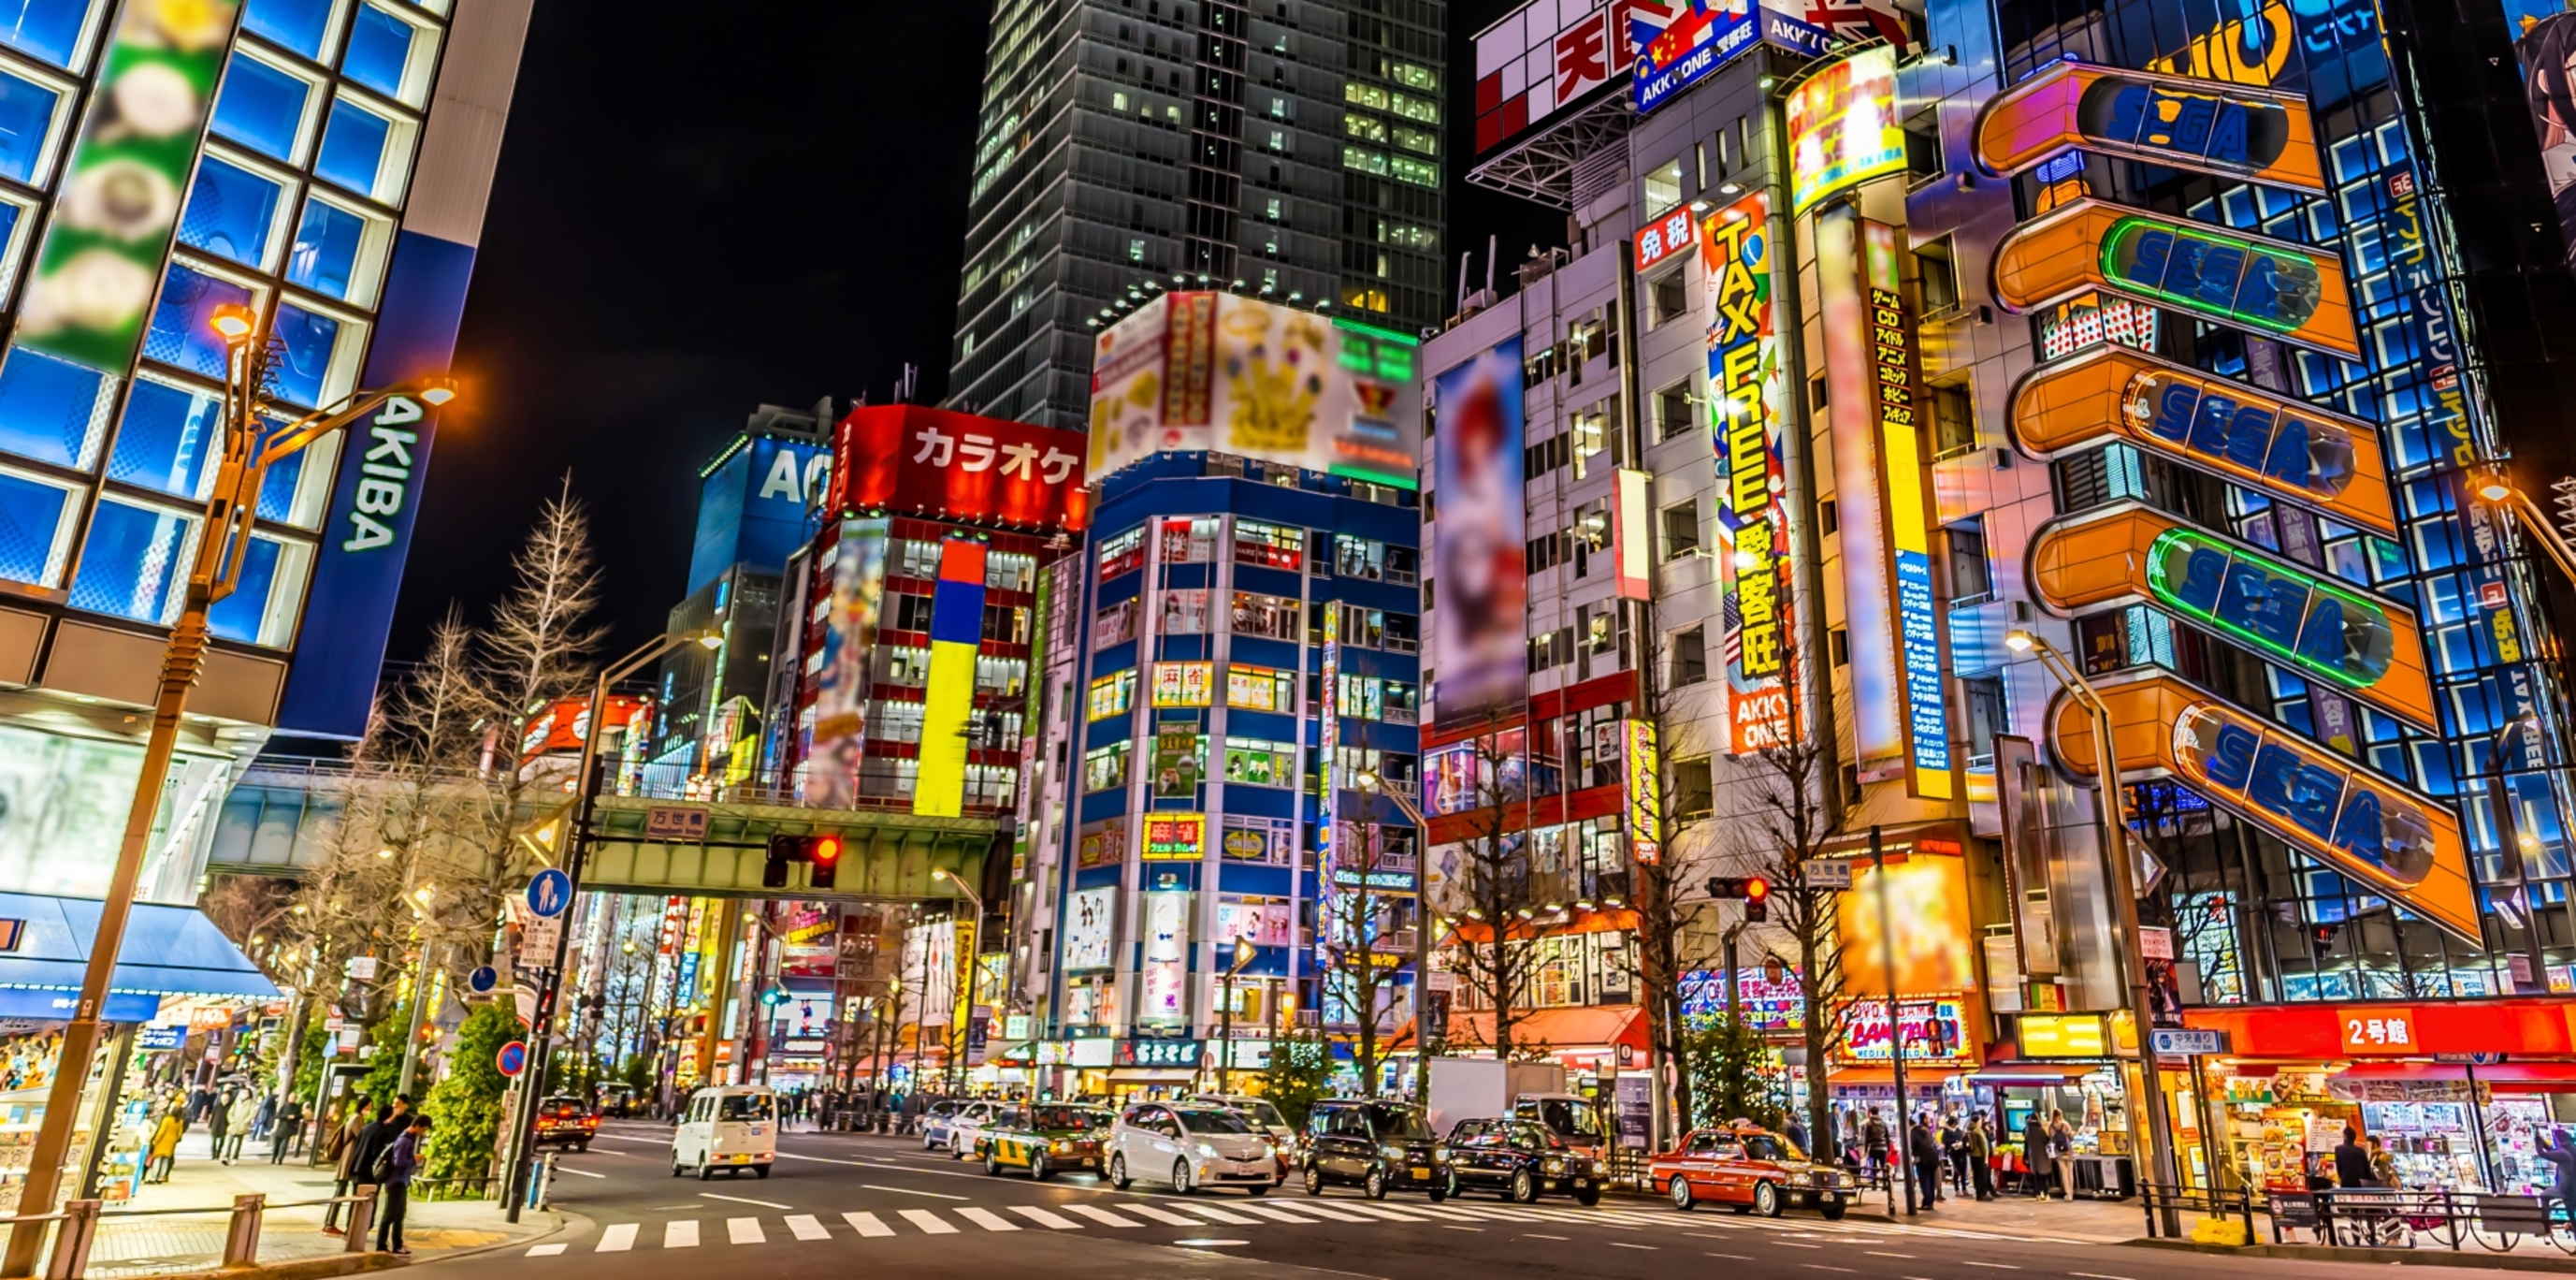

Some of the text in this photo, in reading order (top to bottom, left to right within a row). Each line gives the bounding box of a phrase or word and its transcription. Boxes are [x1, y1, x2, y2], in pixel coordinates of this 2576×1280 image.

[1681, 51, 1712, 78] ONE
[2106, 86, 2248, 162] SEGA
[1641, 211, 1688, 266] 免税
[1715, 214, 1759, 349] TAX
[2128, 230, 2277, 319] SEGA
[1873, 289, 1900, 310] ゲーム
[1877, 309, 1899, 327] CD
[1875, 327, 1903, 347] アイドル
[1877, 346, 1906, 366] アニメ
[1880, 367, 1906, 385] コミック
[1884, 385, 1908, 403] ホビー
[1723, 340, 1770, 516] FREE
[1883, 405, 1911, 424] フィギュア
[2154, 382, 2309, 489] SEGA
[913, 427, 1078, 485] カラオケ
[343, 395, 424, 552] AKIBA
[2178, 546, 2344, 673] SEGA
[1163, 668, 1203, 686] 麻雀
[1737, 699, 1790, 725] AKKY
[1744, 721, 1790, 748] ONE
[2208, 724, 2381, 870] SEGA
[2174, 1033, 2210, 1043] 中央通り
[2348, 1018, 2410, 1045] 2号館
[1857, 1049, 1886, 1058] MEDIA
[2234, 1081, 2252, 1098] B1
